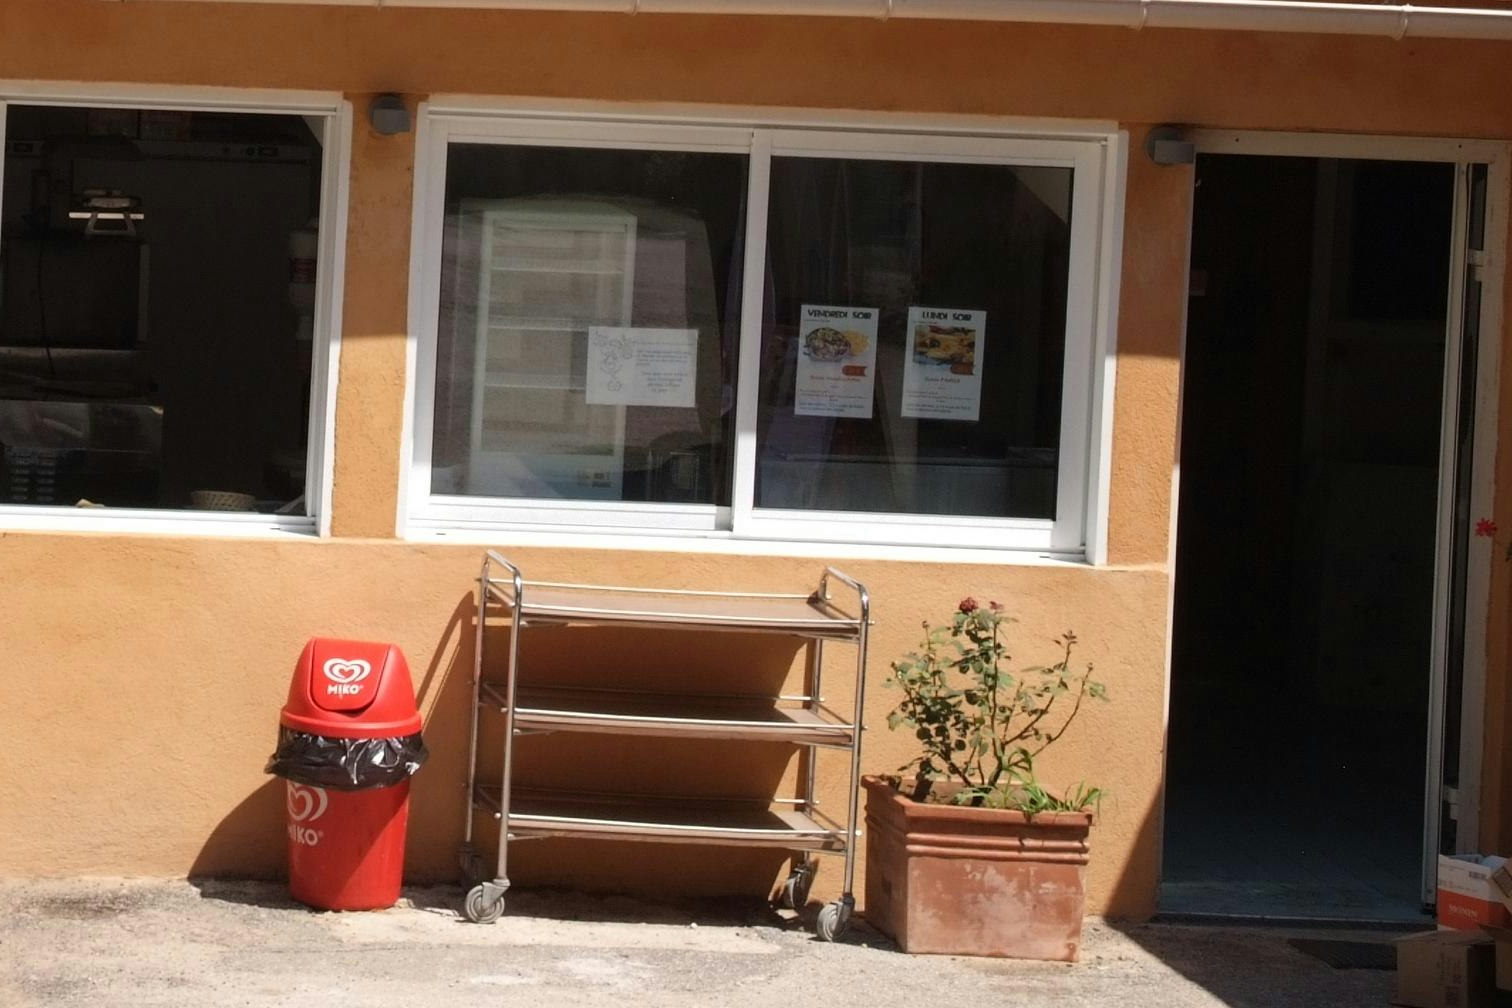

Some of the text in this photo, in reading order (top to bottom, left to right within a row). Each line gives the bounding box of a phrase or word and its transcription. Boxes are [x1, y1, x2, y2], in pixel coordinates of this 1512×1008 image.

[807, 309, 872, 320] VENDREDI SOIR
[922, 311, 972, 321] LUNDI SOIR
[327, 684, 361, 695] MIKO
